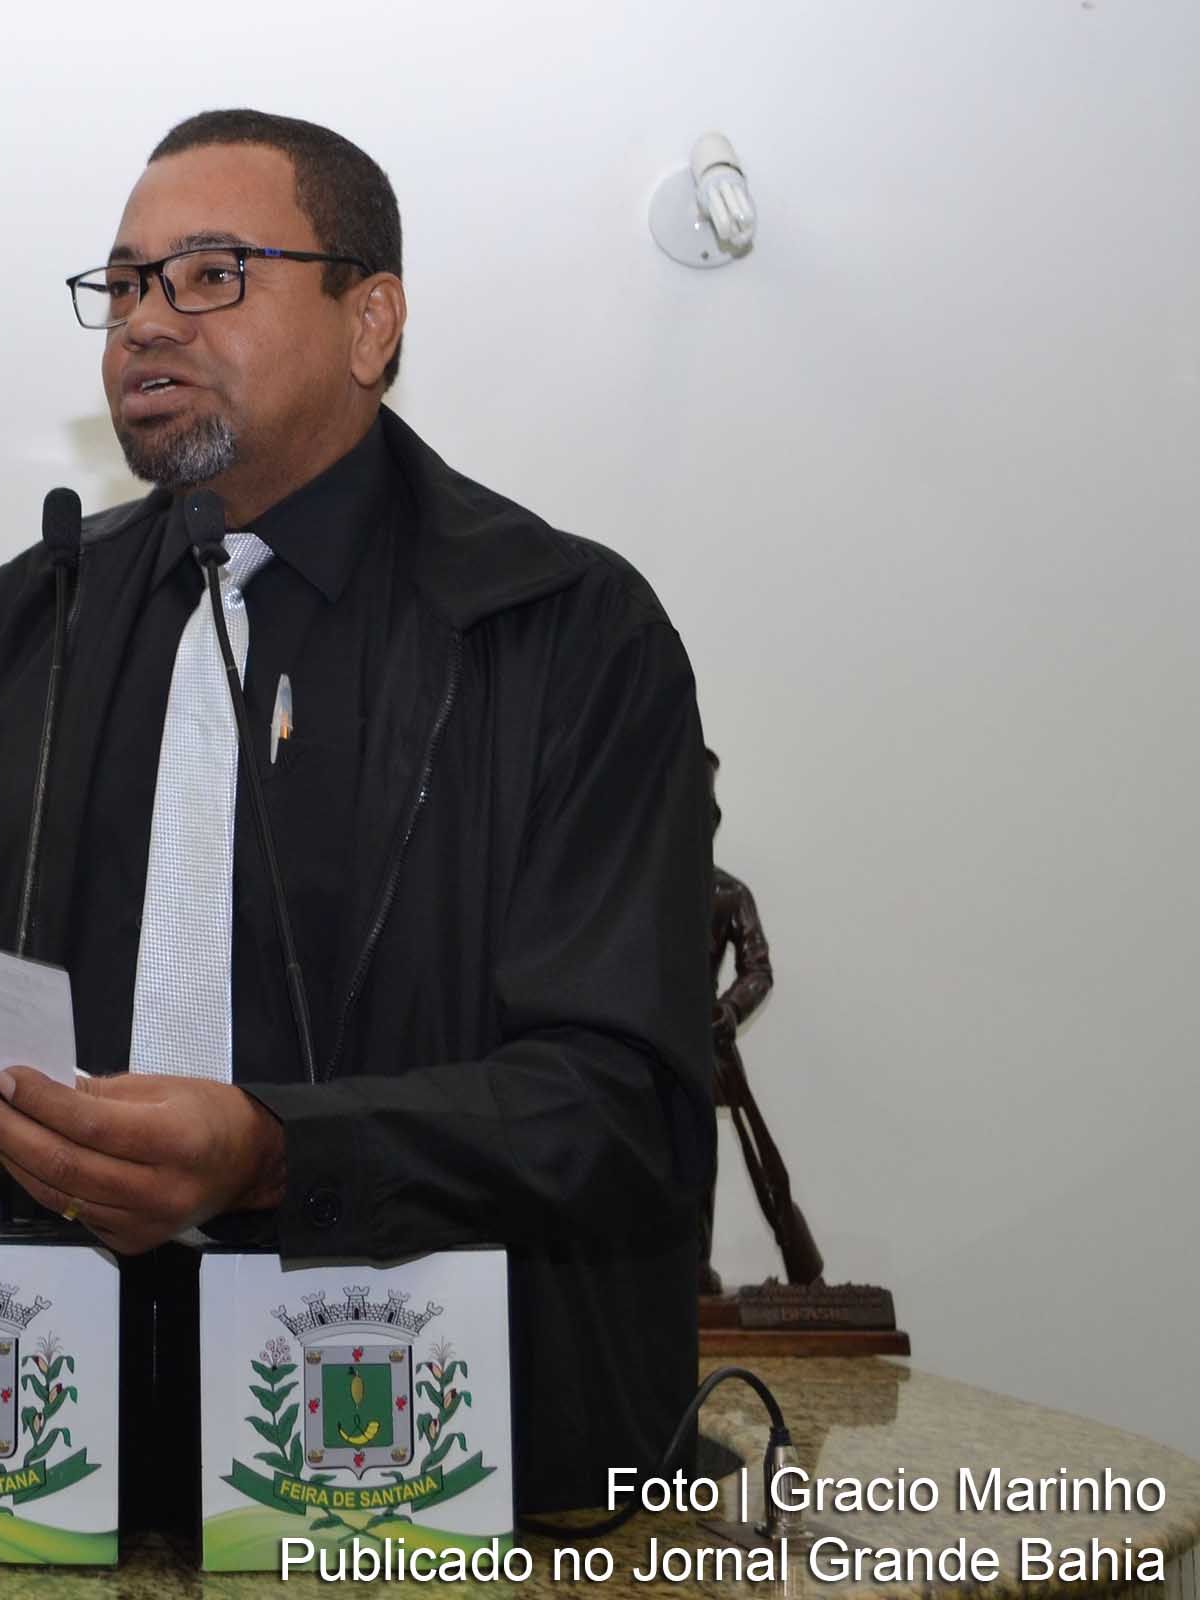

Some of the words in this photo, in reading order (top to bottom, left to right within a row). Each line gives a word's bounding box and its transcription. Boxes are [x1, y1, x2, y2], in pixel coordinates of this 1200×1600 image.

[280, 1479, 329, 1505] FEIRA
[333, 1491, 356, 1507] DE
[360, 1476, 437, 1507] SANTANA
